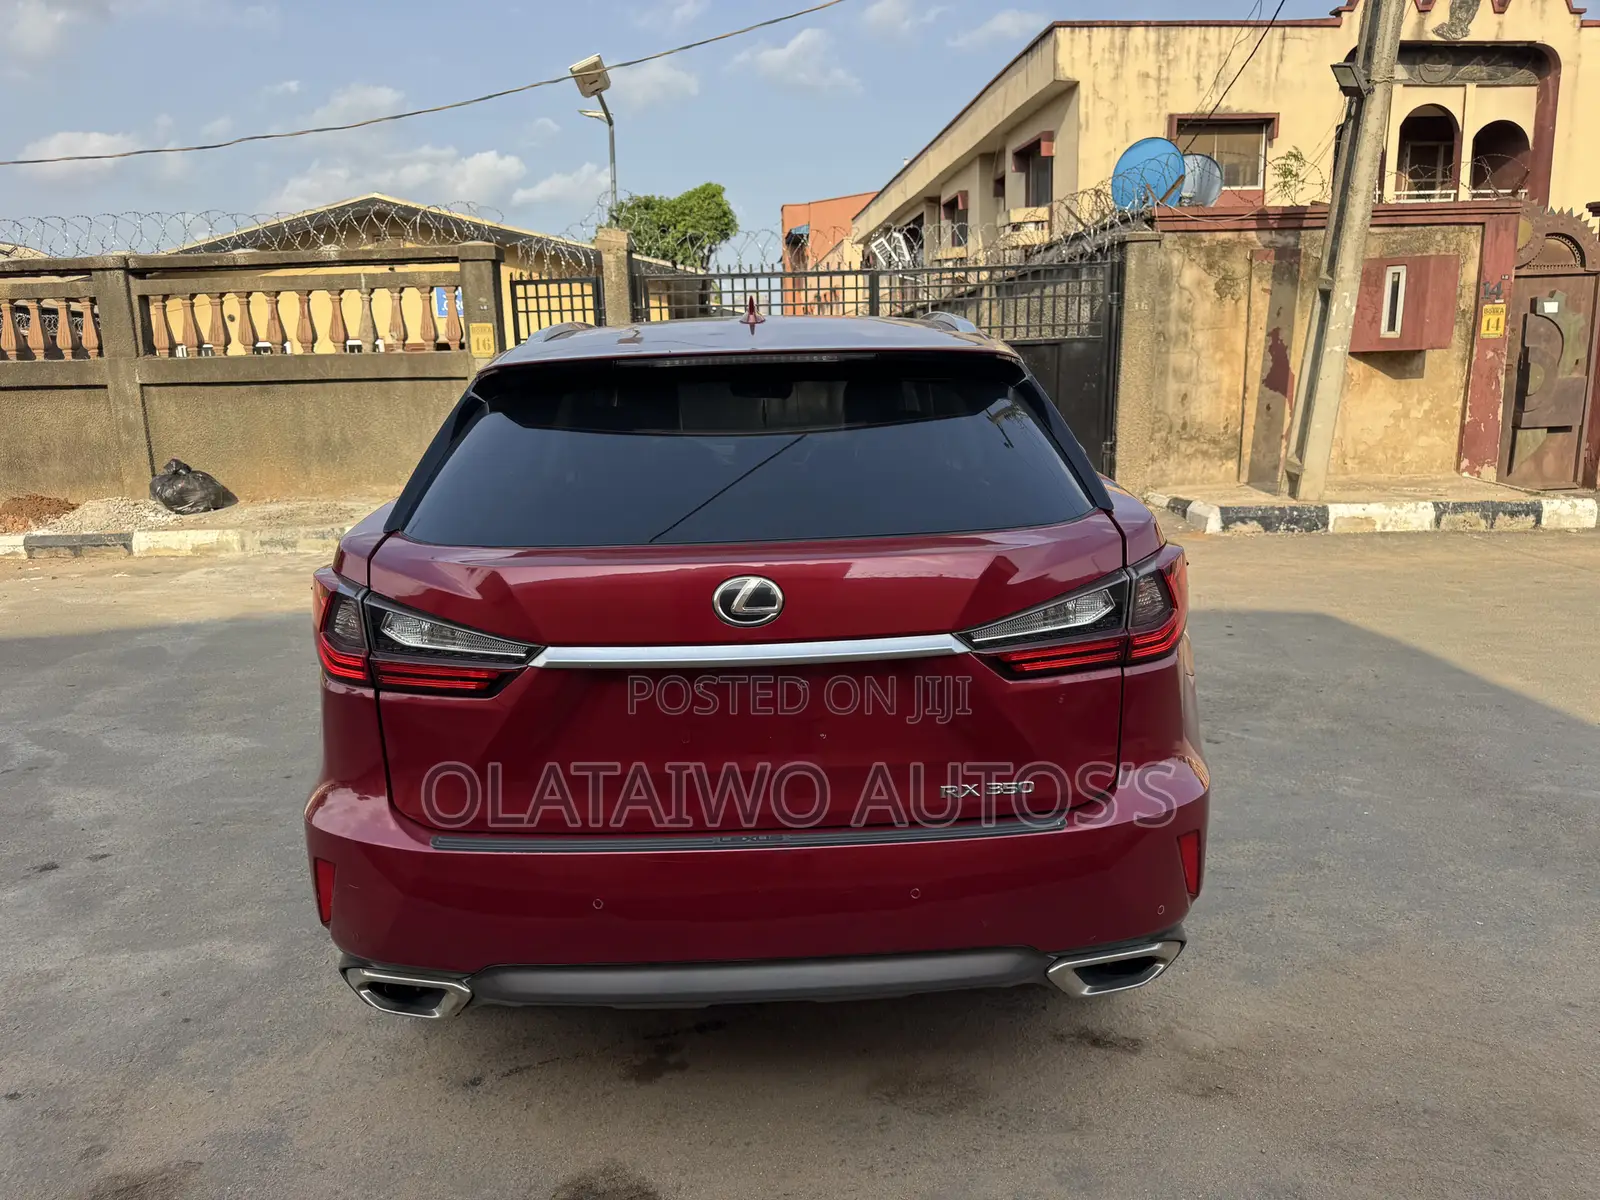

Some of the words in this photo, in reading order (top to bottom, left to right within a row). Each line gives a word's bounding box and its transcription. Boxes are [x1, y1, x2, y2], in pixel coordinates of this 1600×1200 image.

[1481, 281, 1503, 300] 14
[476, 336, 492, 352] 16
[940, 783, 980, 799] RX
[986, 780, 1035, 795] 350
